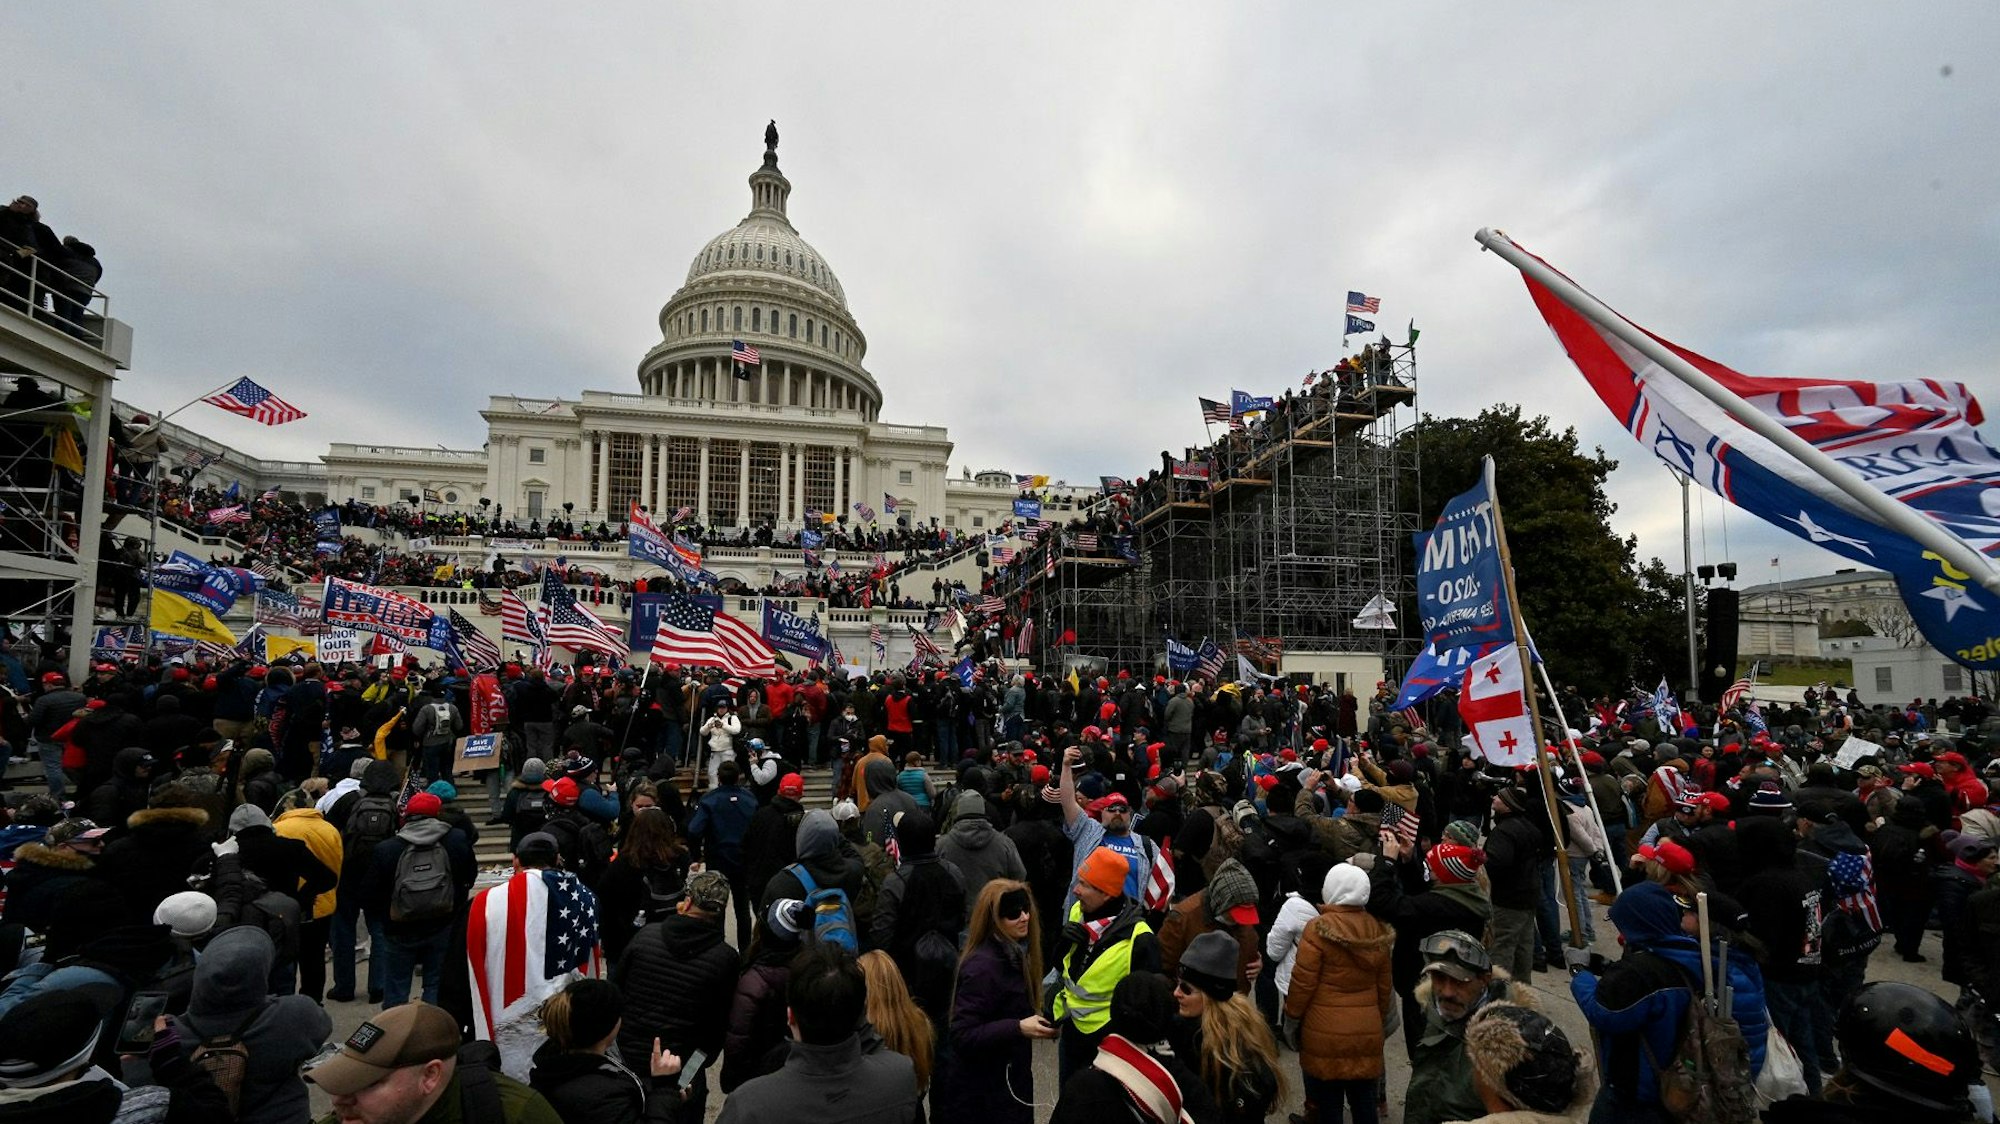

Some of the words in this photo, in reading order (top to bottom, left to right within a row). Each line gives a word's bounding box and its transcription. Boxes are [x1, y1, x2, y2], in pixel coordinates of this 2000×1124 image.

[324, 640, 350, 650] OUR
[322, 652, 355, 661] VOTE
[472, 738, 488, 746] SAVE
[465, 744, 492, 753] AMERICA
